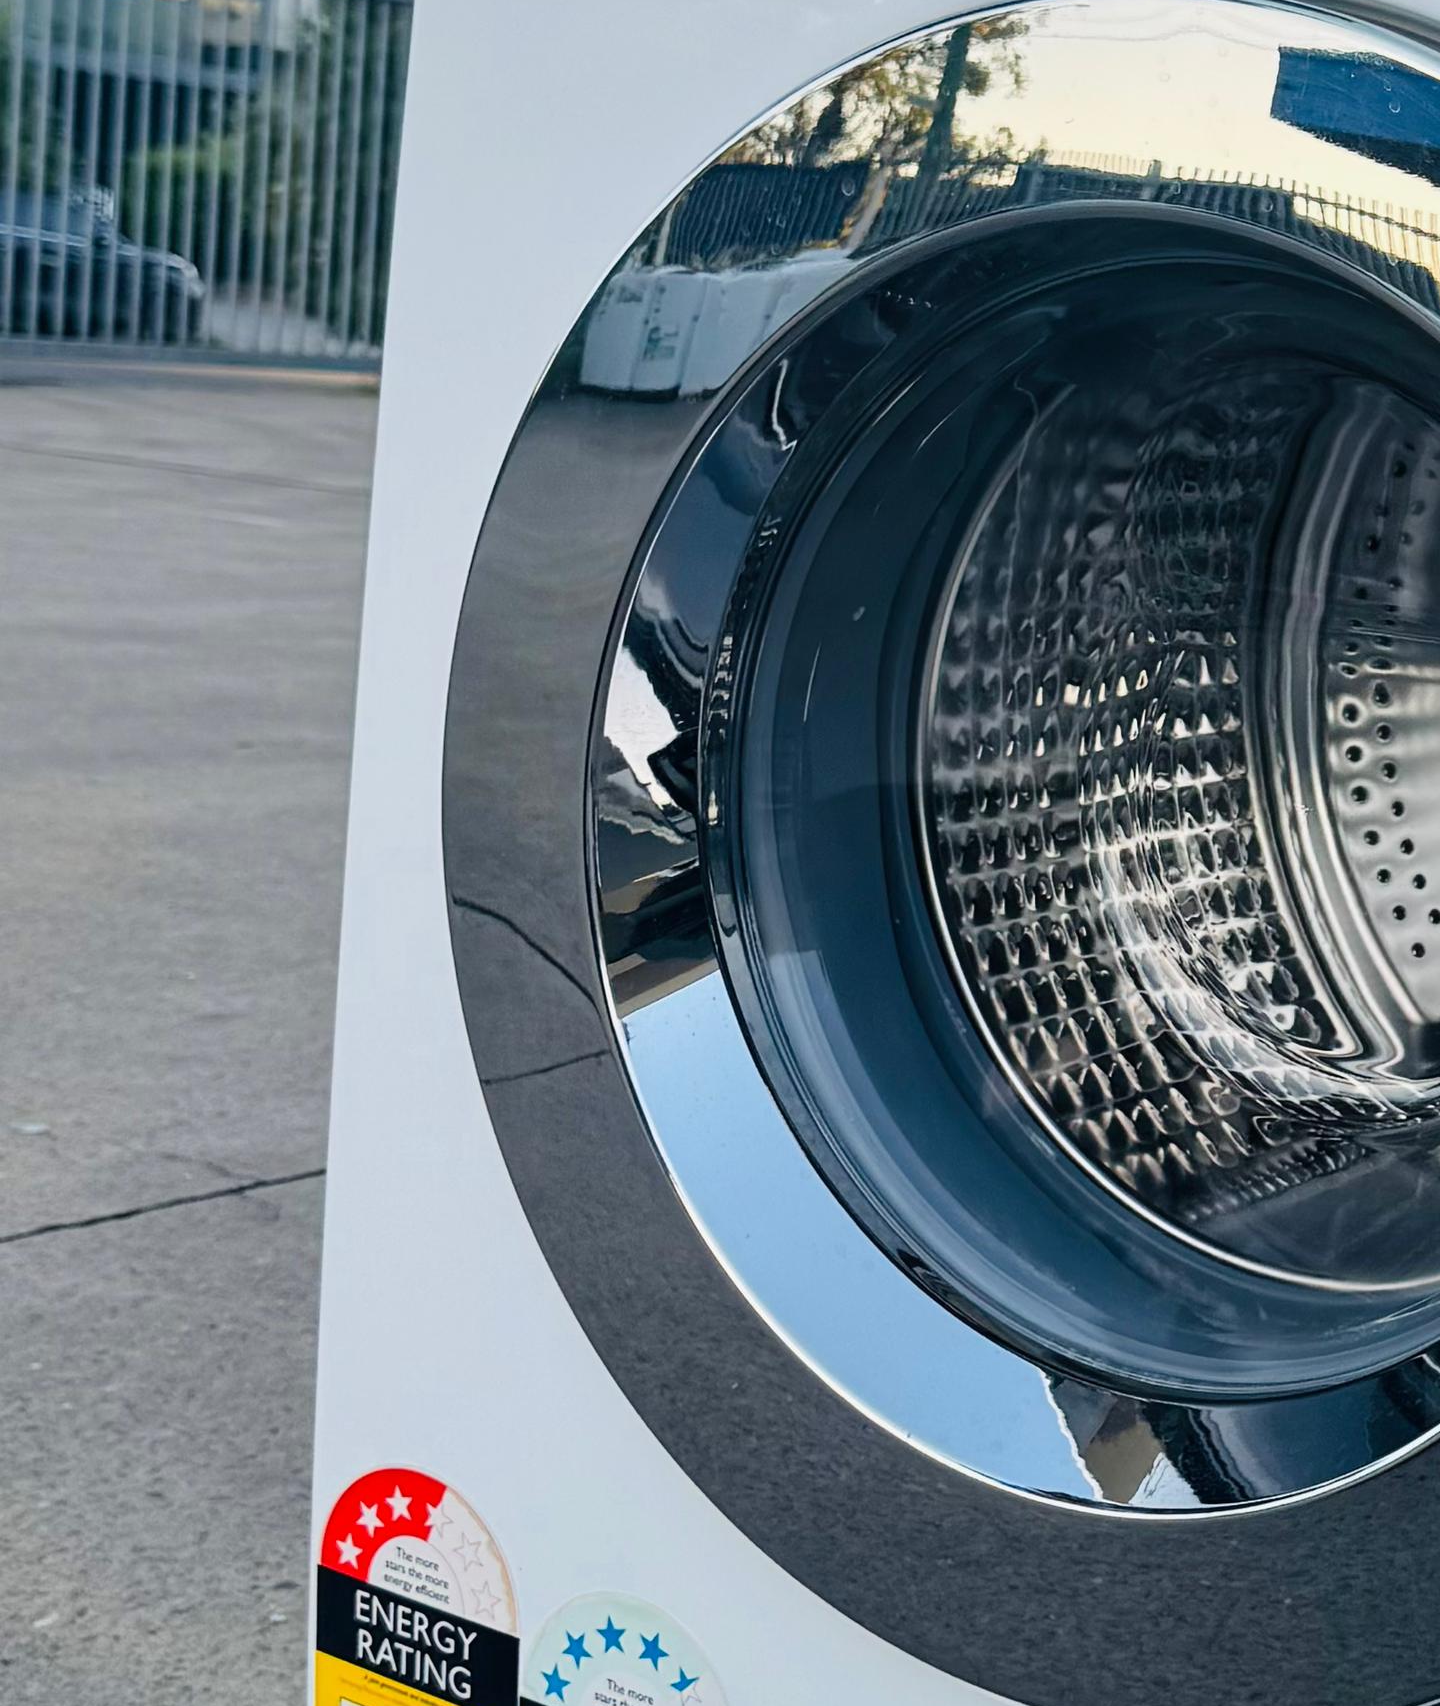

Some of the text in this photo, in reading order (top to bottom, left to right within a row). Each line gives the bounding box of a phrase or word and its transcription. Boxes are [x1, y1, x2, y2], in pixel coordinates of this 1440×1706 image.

[396, 1546, 439, 1572] The more
[384, 1573, 449, 1604] energy efficient
[385, 1560, 449, 1590] stars the more
[354, 1589, 477, 1661] ENERGY
[356, 1628, 472, 1700] RATING
[606, 1678, 654, 1705] The more
